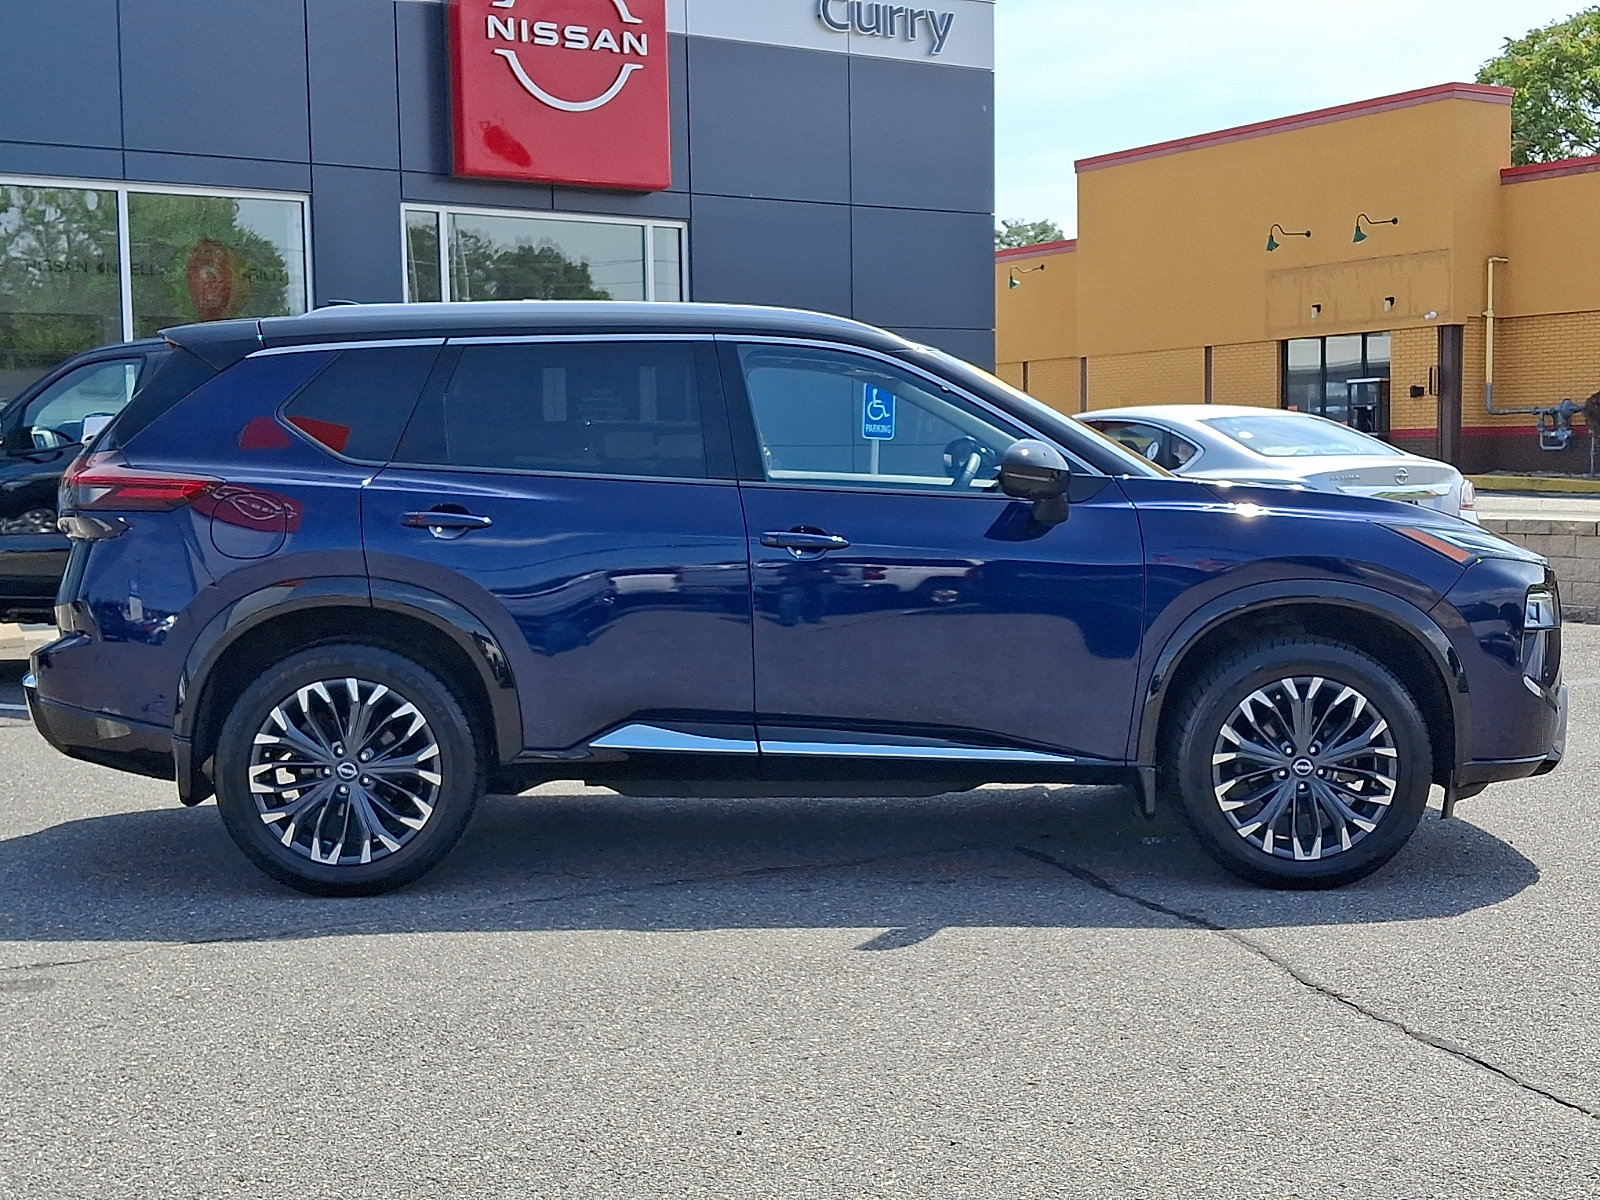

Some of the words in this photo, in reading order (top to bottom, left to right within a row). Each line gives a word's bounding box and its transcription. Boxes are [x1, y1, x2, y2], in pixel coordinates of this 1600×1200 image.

[486, 14, 648, 56] NISSAN
[819, 0, 955, 55] Curry
[865, 424, 892, 433] PARKING
